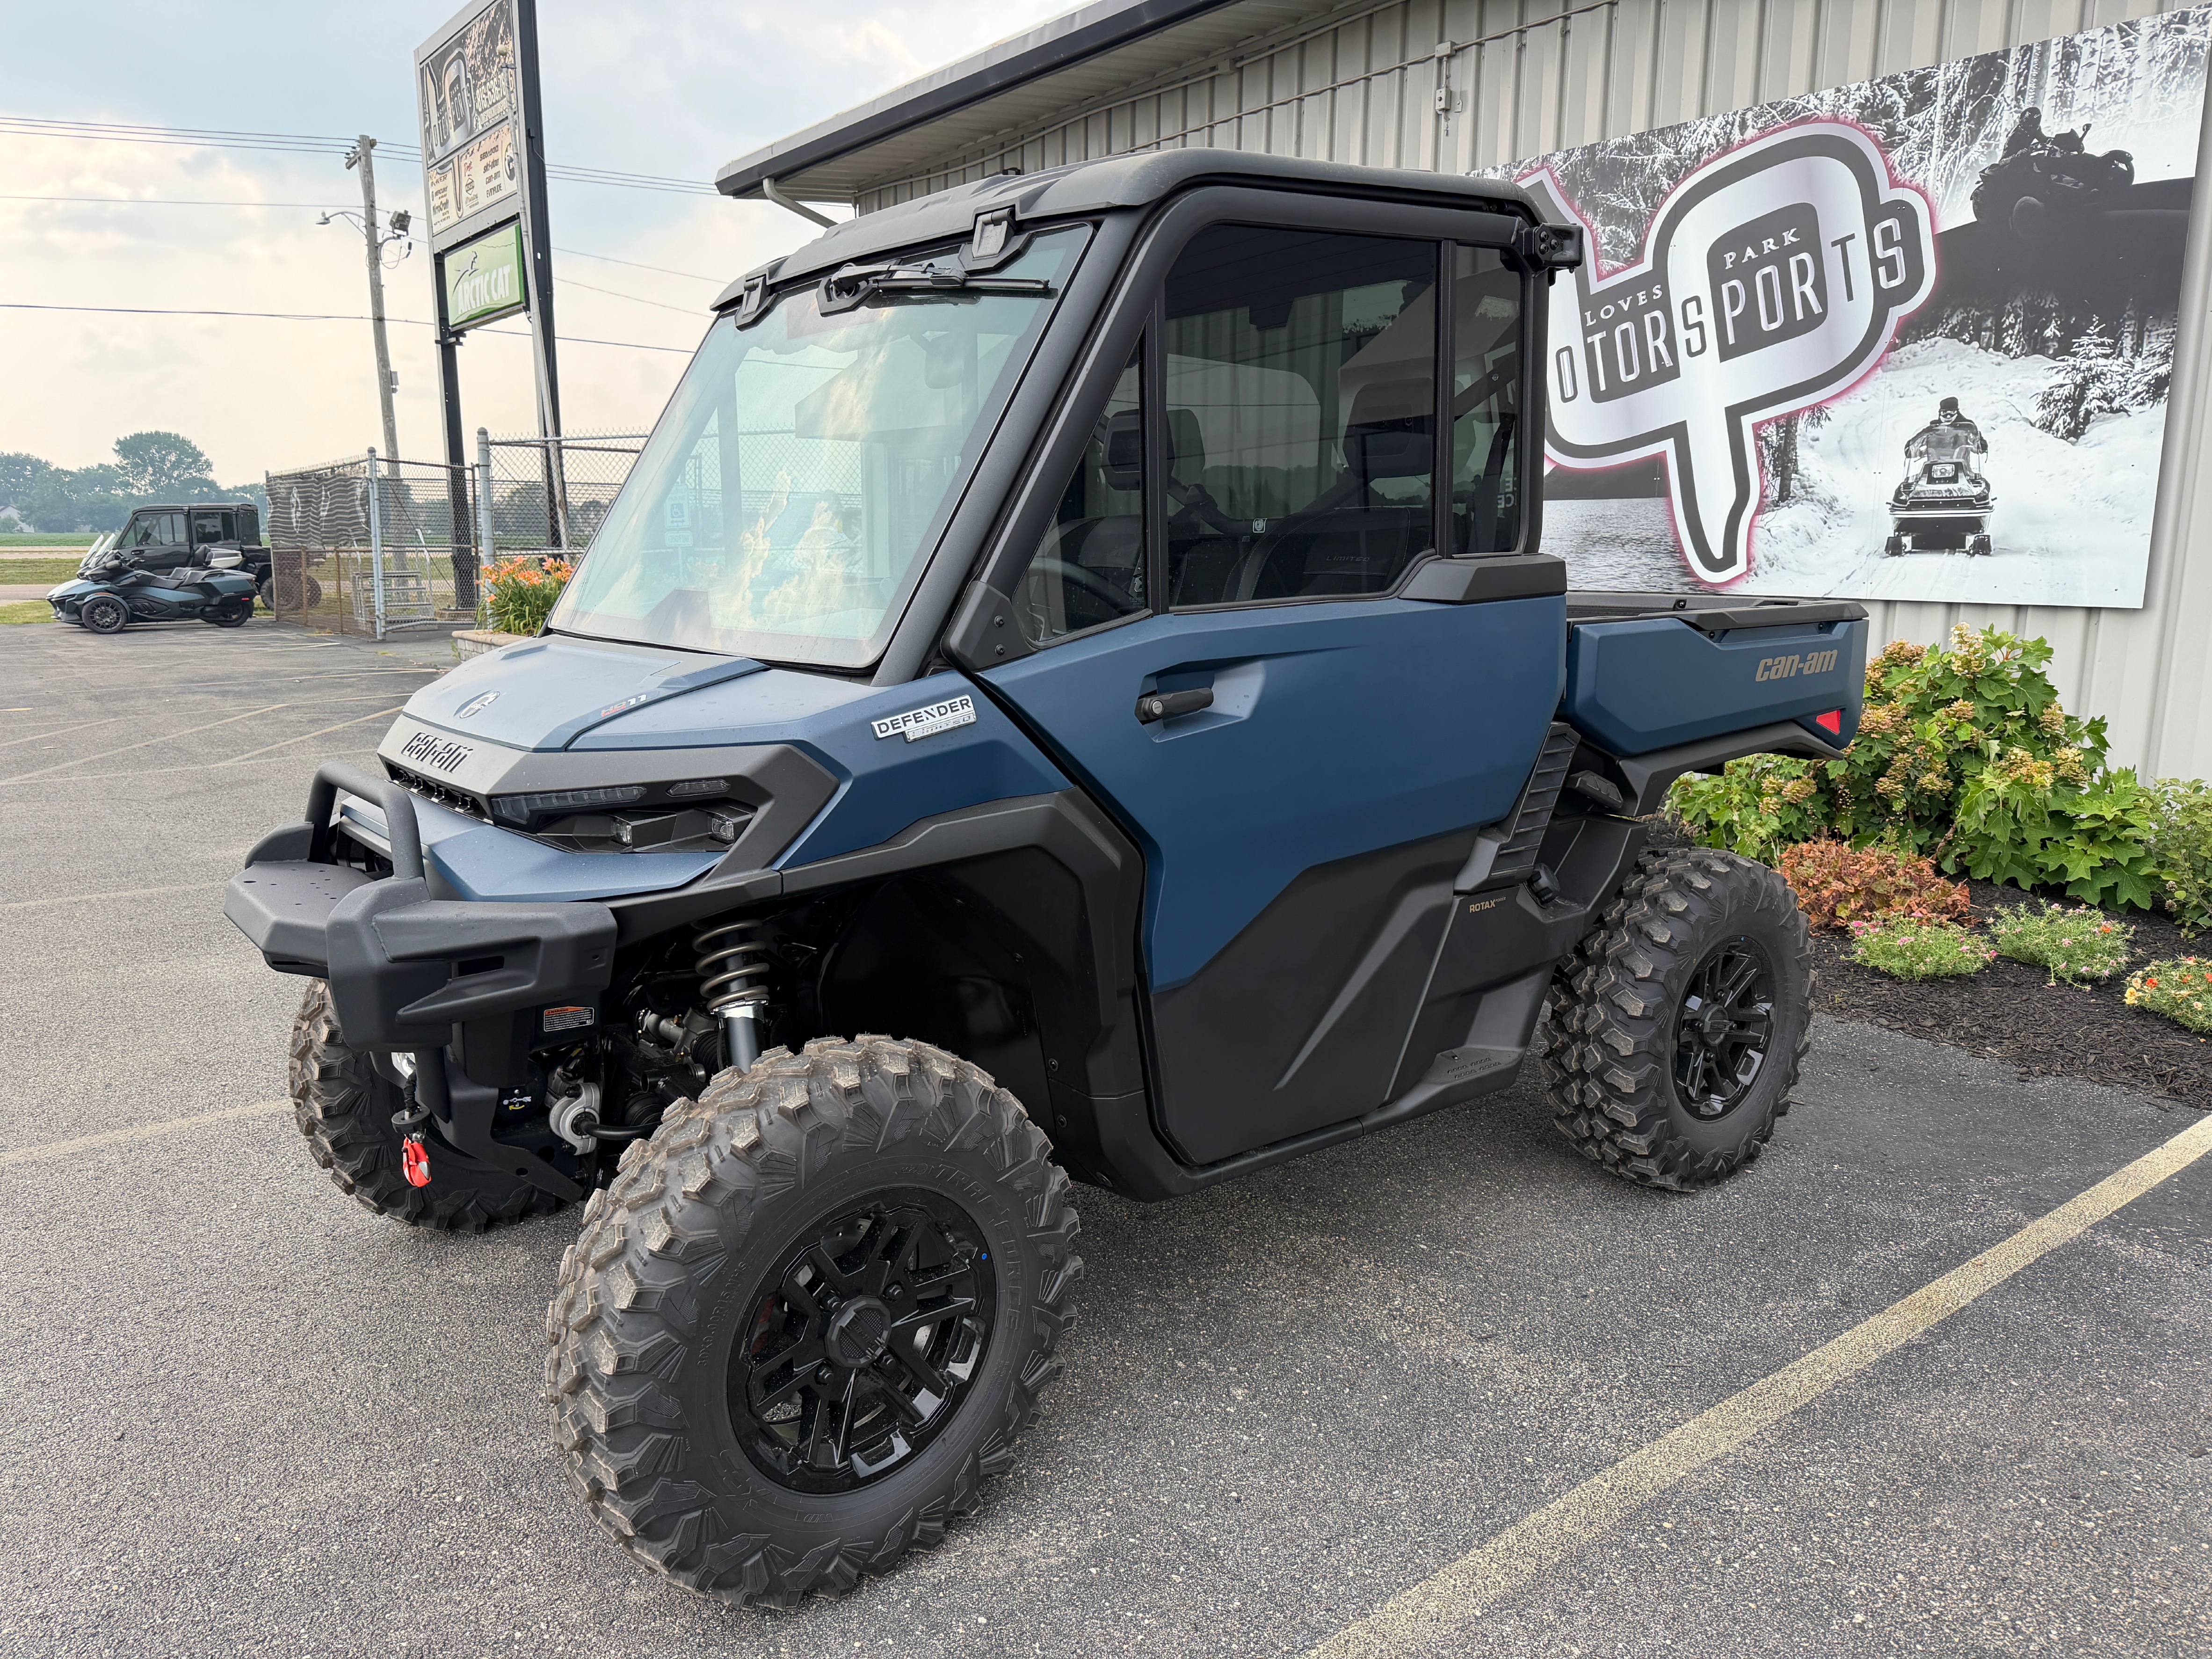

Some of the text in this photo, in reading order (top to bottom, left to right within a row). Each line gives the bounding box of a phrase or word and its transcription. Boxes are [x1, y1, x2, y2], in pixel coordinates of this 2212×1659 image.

[457, 263, 511, 314] ARCTIC CAT
[1585, 227, 1800, 327] LOVES PARK
[1555, 218, 1907, 403] OTORSPORTS
[1755, 649, 1838, 682] can-am
[877, 698, 972, 735] DEFENDER
[401, 732, 474, 774] can-am
[1469, 899, 1495, 913] ROTAX
